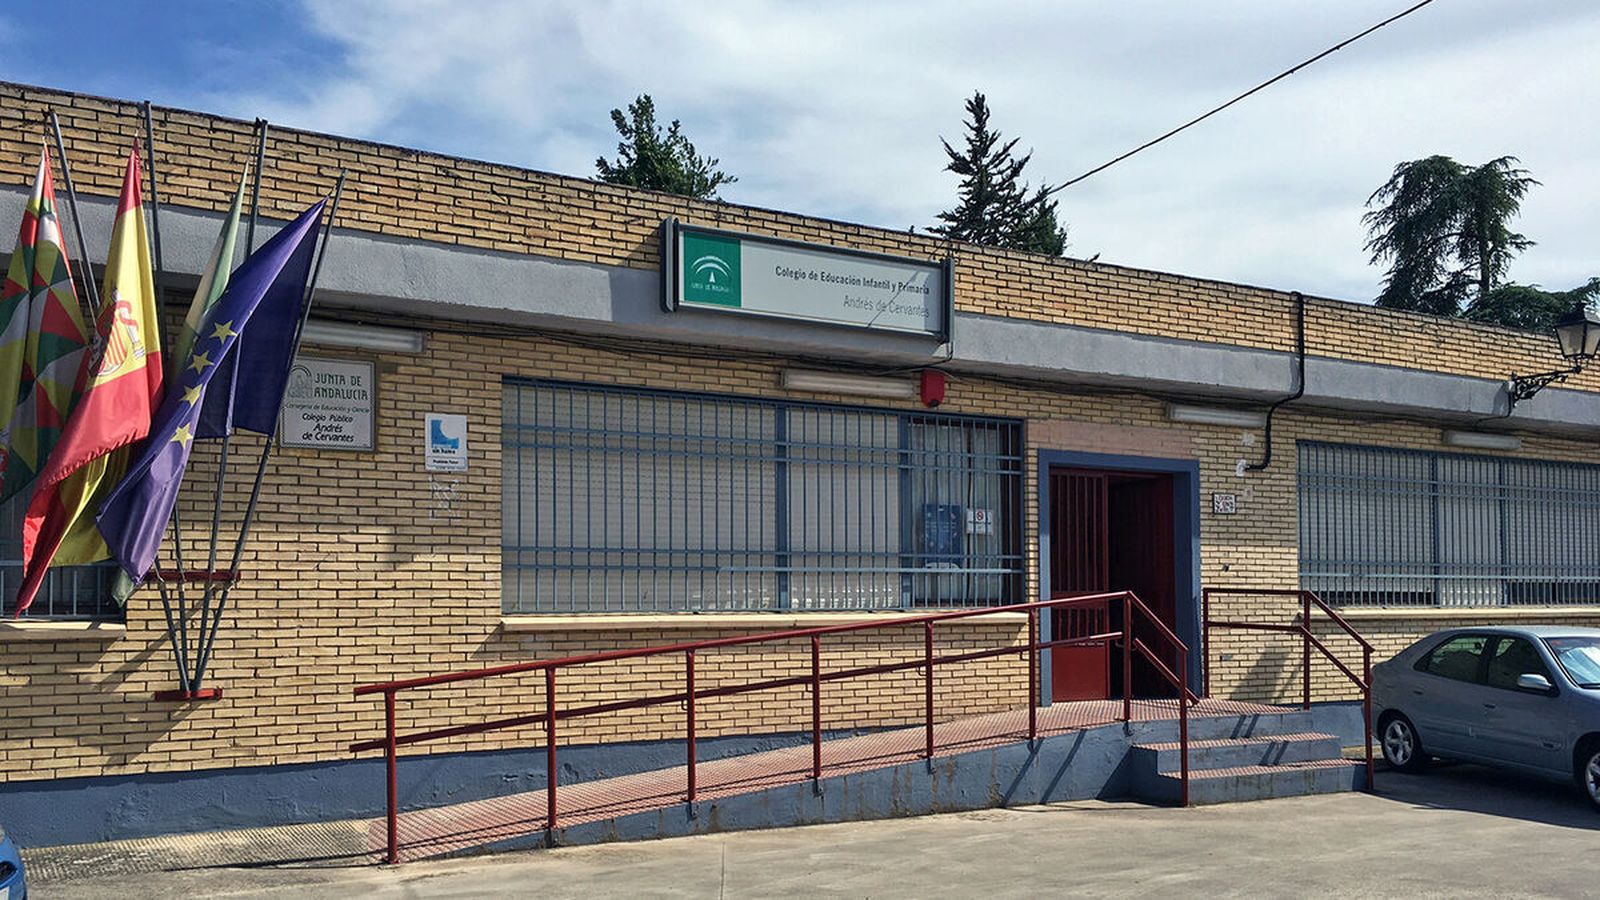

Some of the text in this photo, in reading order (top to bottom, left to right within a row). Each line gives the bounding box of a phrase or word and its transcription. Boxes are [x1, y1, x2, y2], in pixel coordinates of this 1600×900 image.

[775, 265, 930, 295] Colegio de Educación Infantil y Primaria
[843, 295, 930, 318] Andrés de Cervantes
[314, 373, 362, 387] JUNTA DE
[302, 413, 354, 423] Colegio Público
[313, 423, 343, 432] Andrés
[302, 432, 354, 442] de Cervantes
